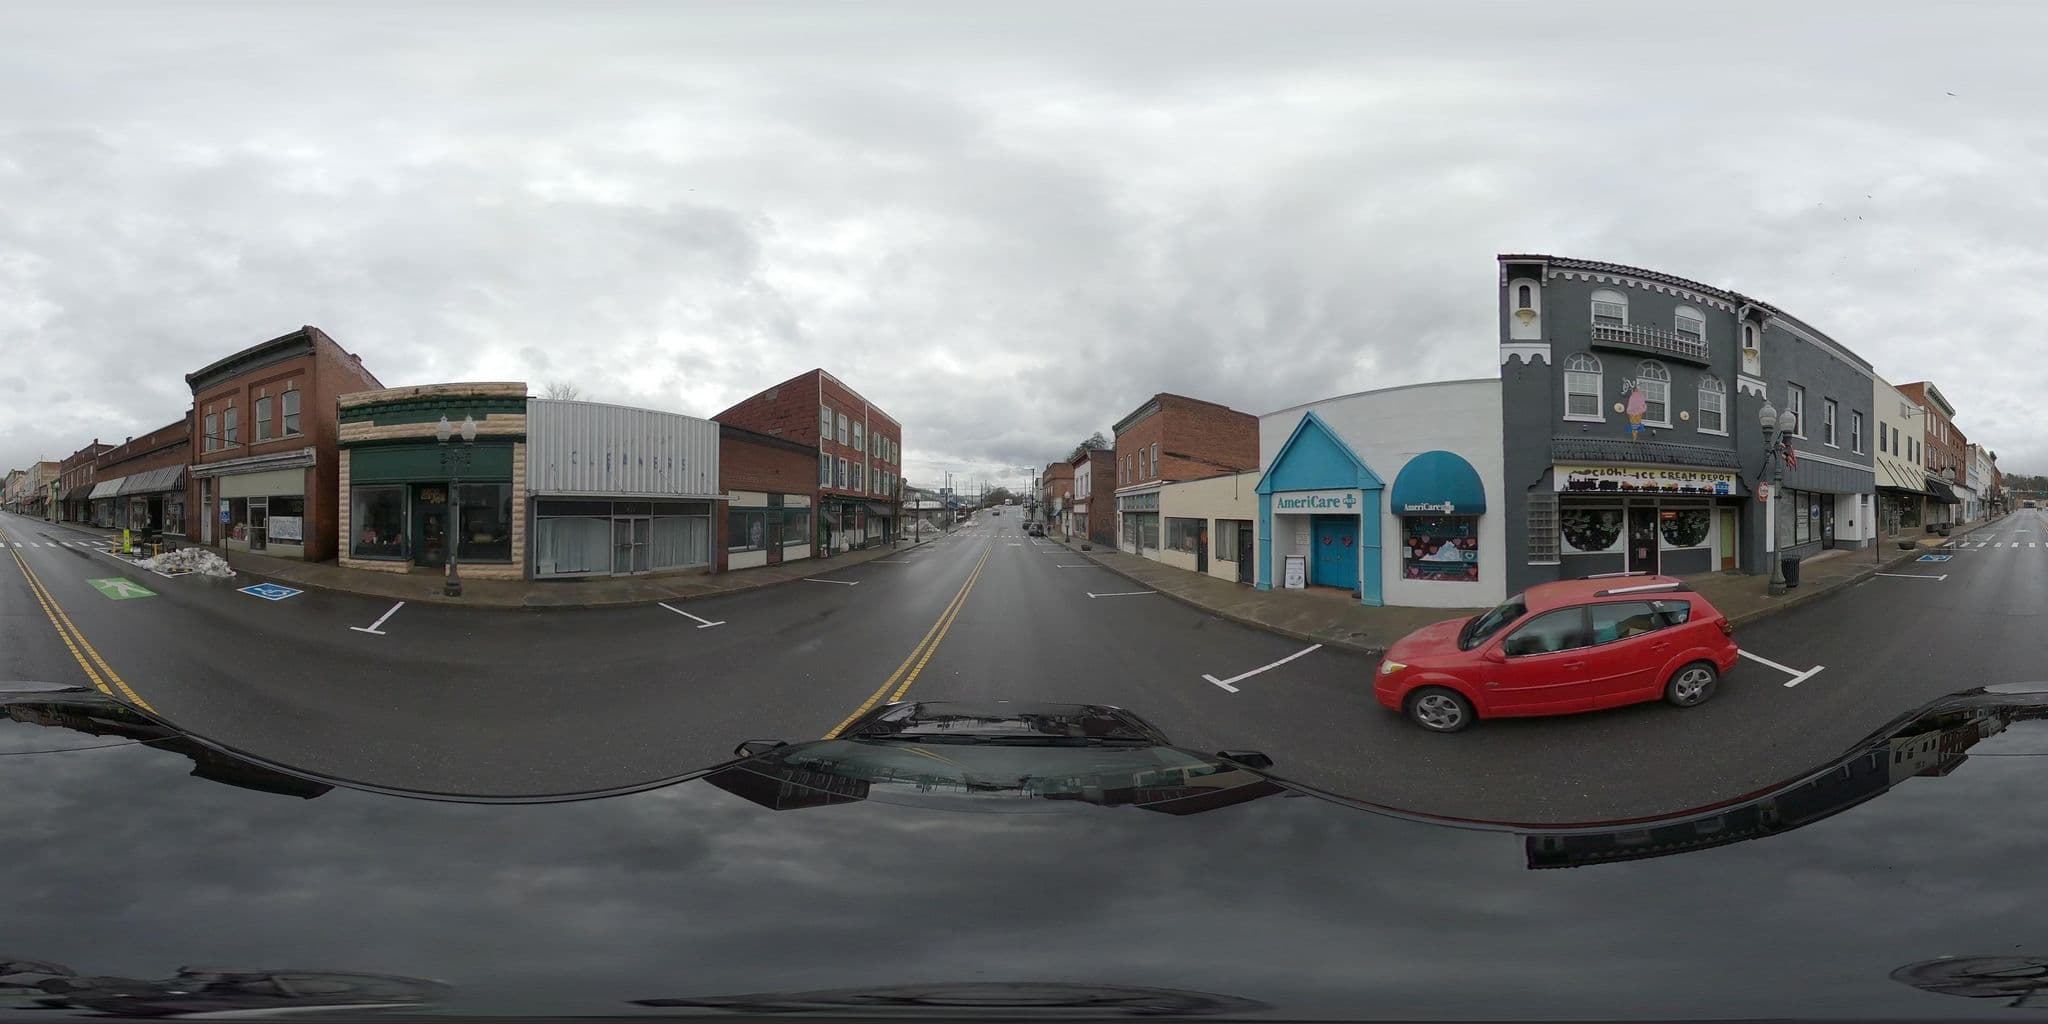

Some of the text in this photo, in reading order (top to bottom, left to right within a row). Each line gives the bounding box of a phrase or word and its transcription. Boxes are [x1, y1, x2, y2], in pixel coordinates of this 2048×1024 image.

[1635, 471, 1656, 480] ICE
[1660, 471, 1697, 481] CREAM
[1700, 473, 1732, 482] DEPOT
[1277, 495, 1341, 509] AmeriCare
[1404, 502, 1442, 511] AmeriCare
